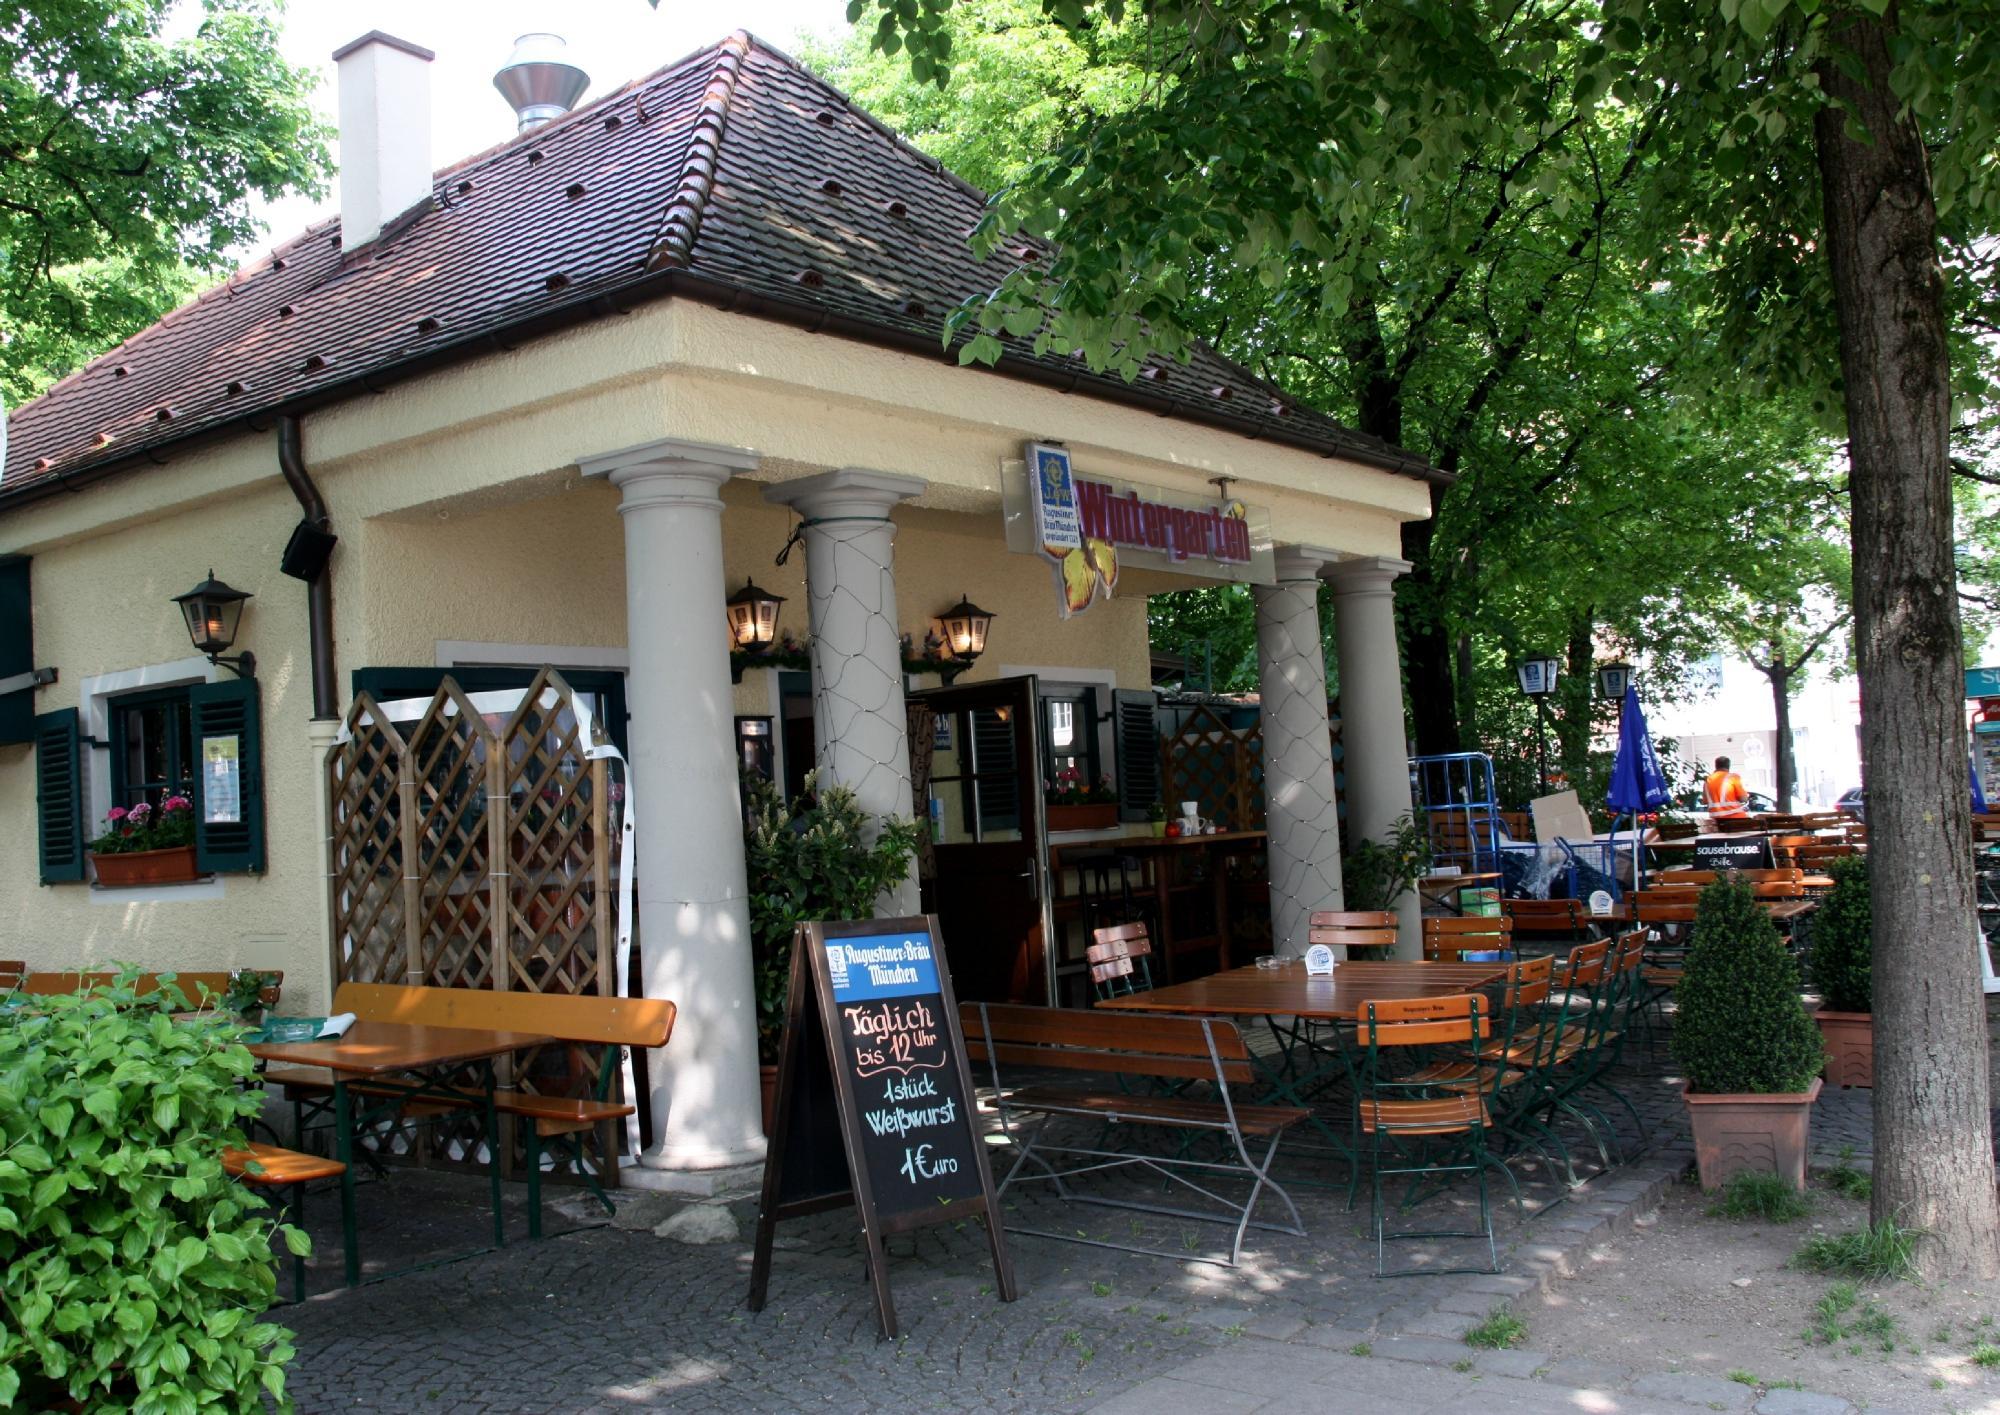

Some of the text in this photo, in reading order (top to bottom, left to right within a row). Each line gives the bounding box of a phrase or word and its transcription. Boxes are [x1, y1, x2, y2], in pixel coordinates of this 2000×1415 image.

[1075, 480, 1251, 562] Wintergarten
[868, 964, 918, 986] München
[845, 1001, 935, 1045] Täglich
[856, 1030, 936, 1065] bis 12 Uhr
[866, 1096, 956, 1138] Weißwurst
